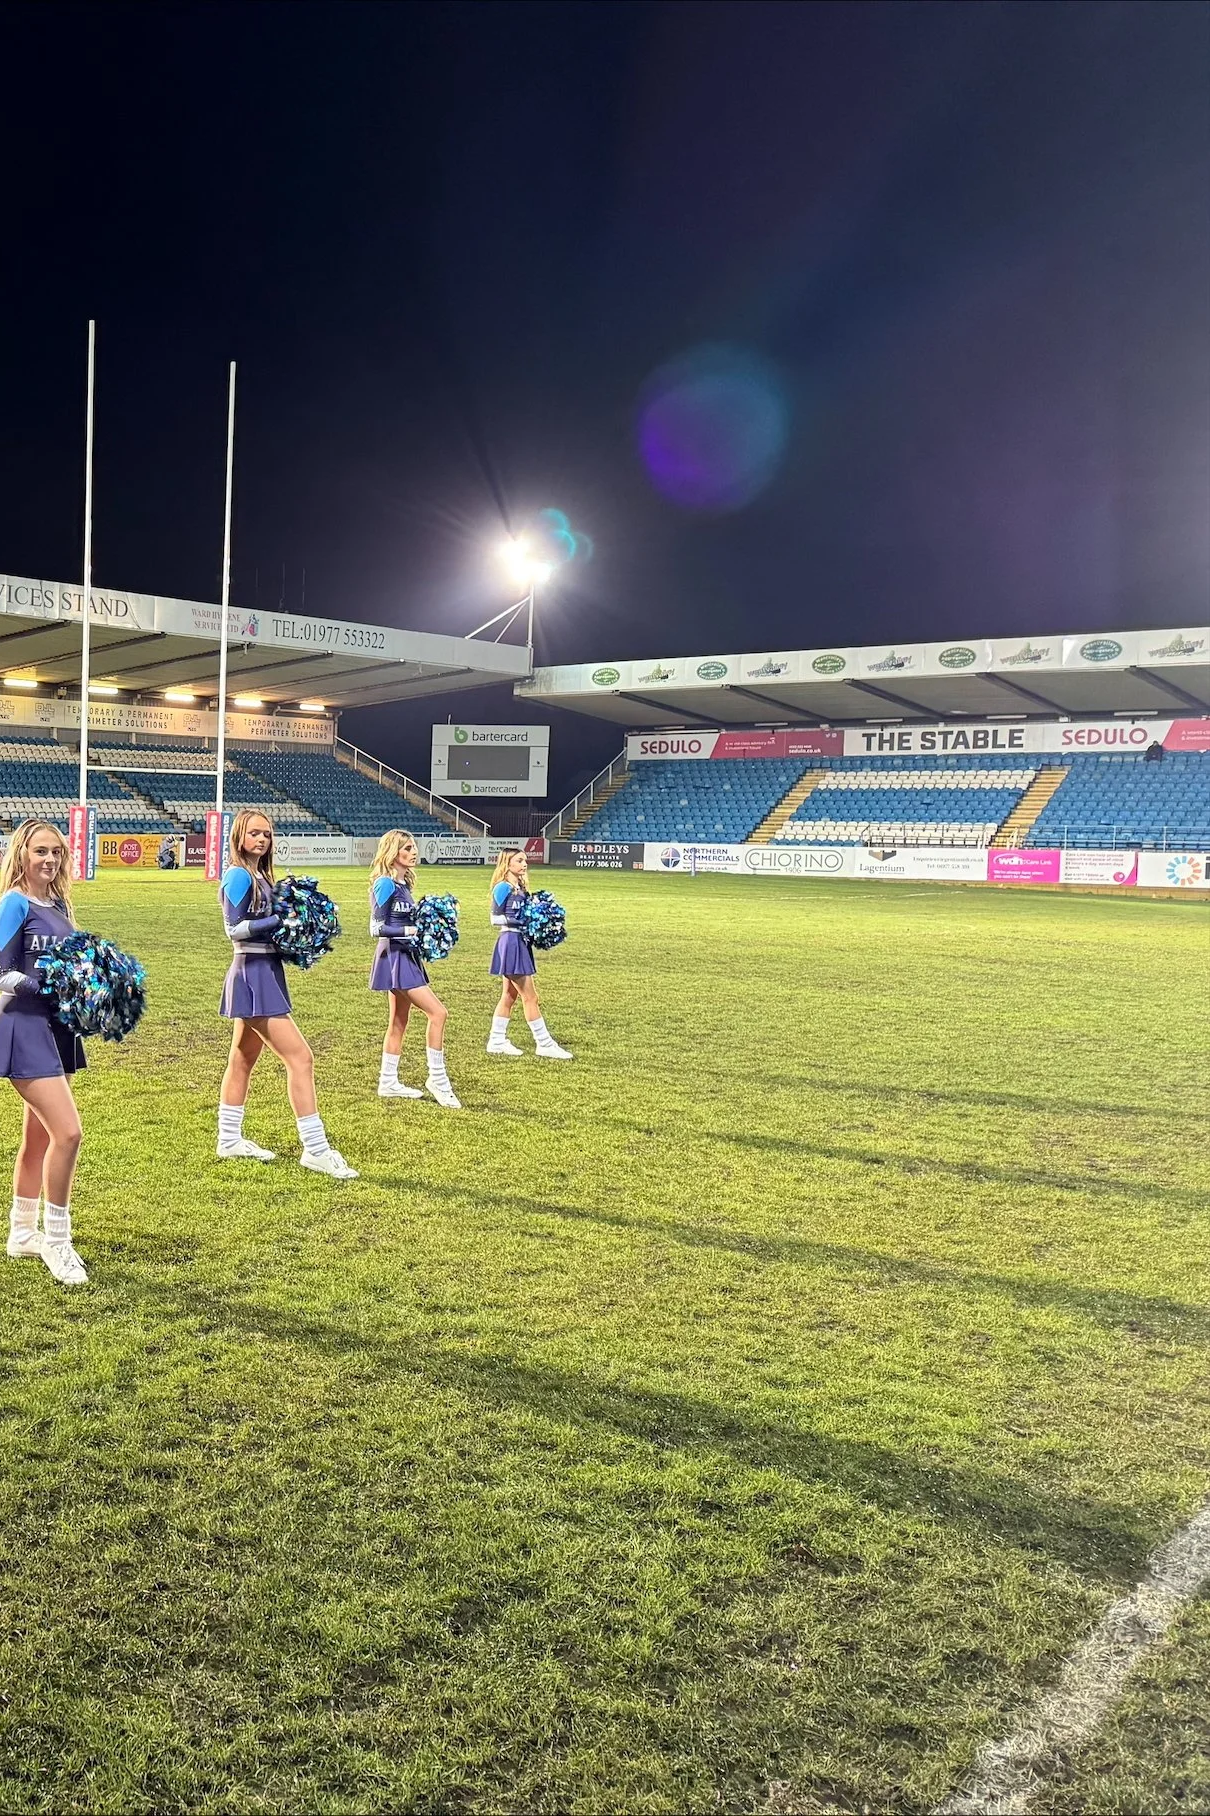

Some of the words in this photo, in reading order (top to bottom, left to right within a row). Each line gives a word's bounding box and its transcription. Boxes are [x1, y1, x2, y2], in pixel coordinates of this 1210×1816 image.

[191, 607, 211, 618] WARD
[195, 619, 223, 631] SERVICE
[272, 619, 340, 644] TEL:01977
[344, 628, 385, 649] 553322
[127, 710, 174, 721] PERMANENT
[76, 717, 122, 726] PRIMETER
[125, 719, 168, 730] SOLUTIONS
[244, 718, 284, 728] TEMPORARY
[293, 722, 333, 733] PERMANENT
[251, 727, 289, 737] PERIMETER
[292, 730, 328, 740] SOLUTIONS
[472, 731, 529, 742] bartercard
[862, 732, 912, 752] THE
[920, 728, 1024, 750] STABLE
[1061, 727, 1148, 746] SEDULO
[640, 739, 702, 755] SEDULO
[474, 784, 518, 793] bartercard
[73, 810, 83, 879] BETFRED
[87, 810, 95, 879] BETFRED
[102, 840, 117, 855] BB
[123, 843, 137, 851] POST
[208, 815, 217, 878] BETFRED
[120, 850, 139, 858] OFFICE
[748, 852, 840, 868] CHIORINO
[576, 860, 596, 868] 01977
[596, 860, 609, 868] 306
[609, 860, 623, 868] 026
[860, 863, 905, 874] Lagentium
